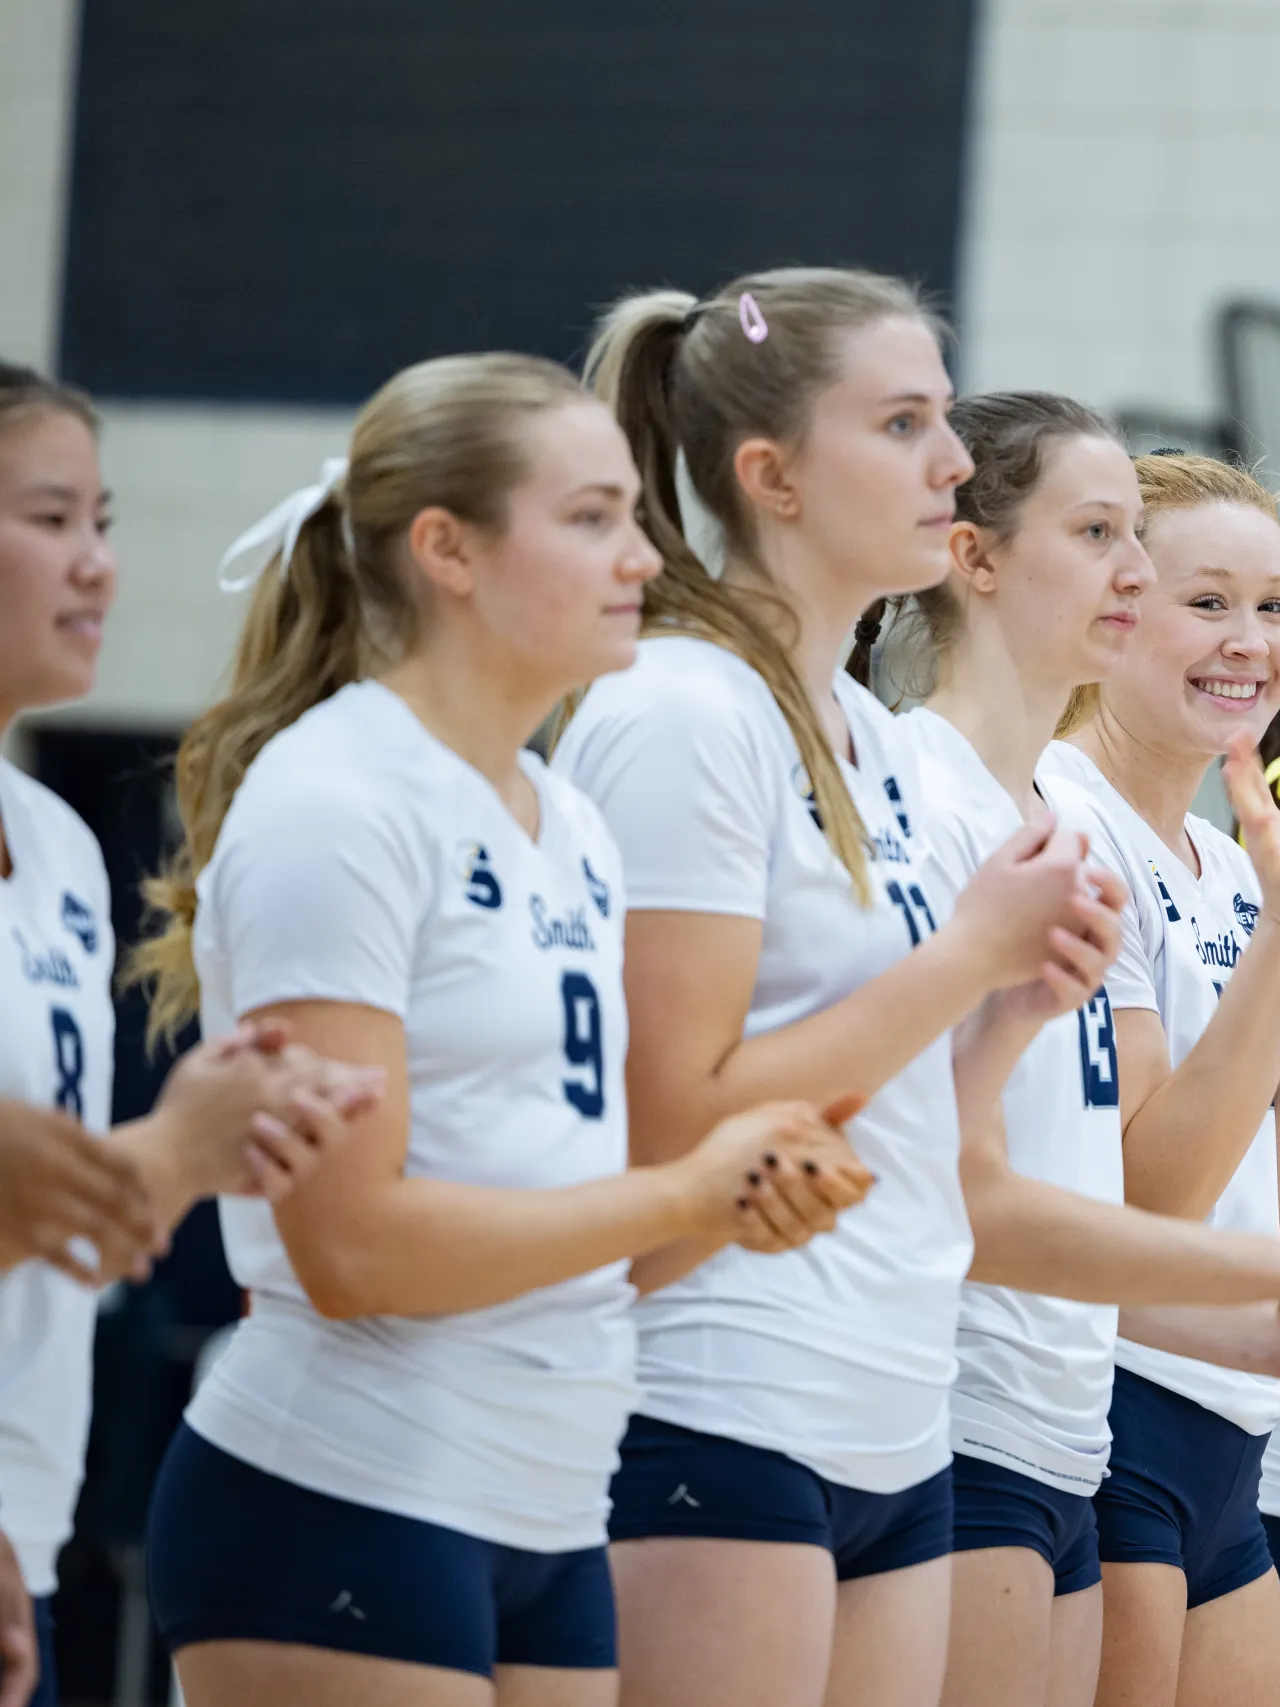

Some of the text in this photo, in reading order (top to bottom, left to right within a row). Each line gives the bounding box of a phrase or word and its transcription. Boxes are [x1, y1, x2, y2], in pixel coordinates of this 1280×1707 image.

[530, 893, 598, 953] Smith
[1190, 916, 1244, 969] Smith
[561, 969, 605, 1121] 9
